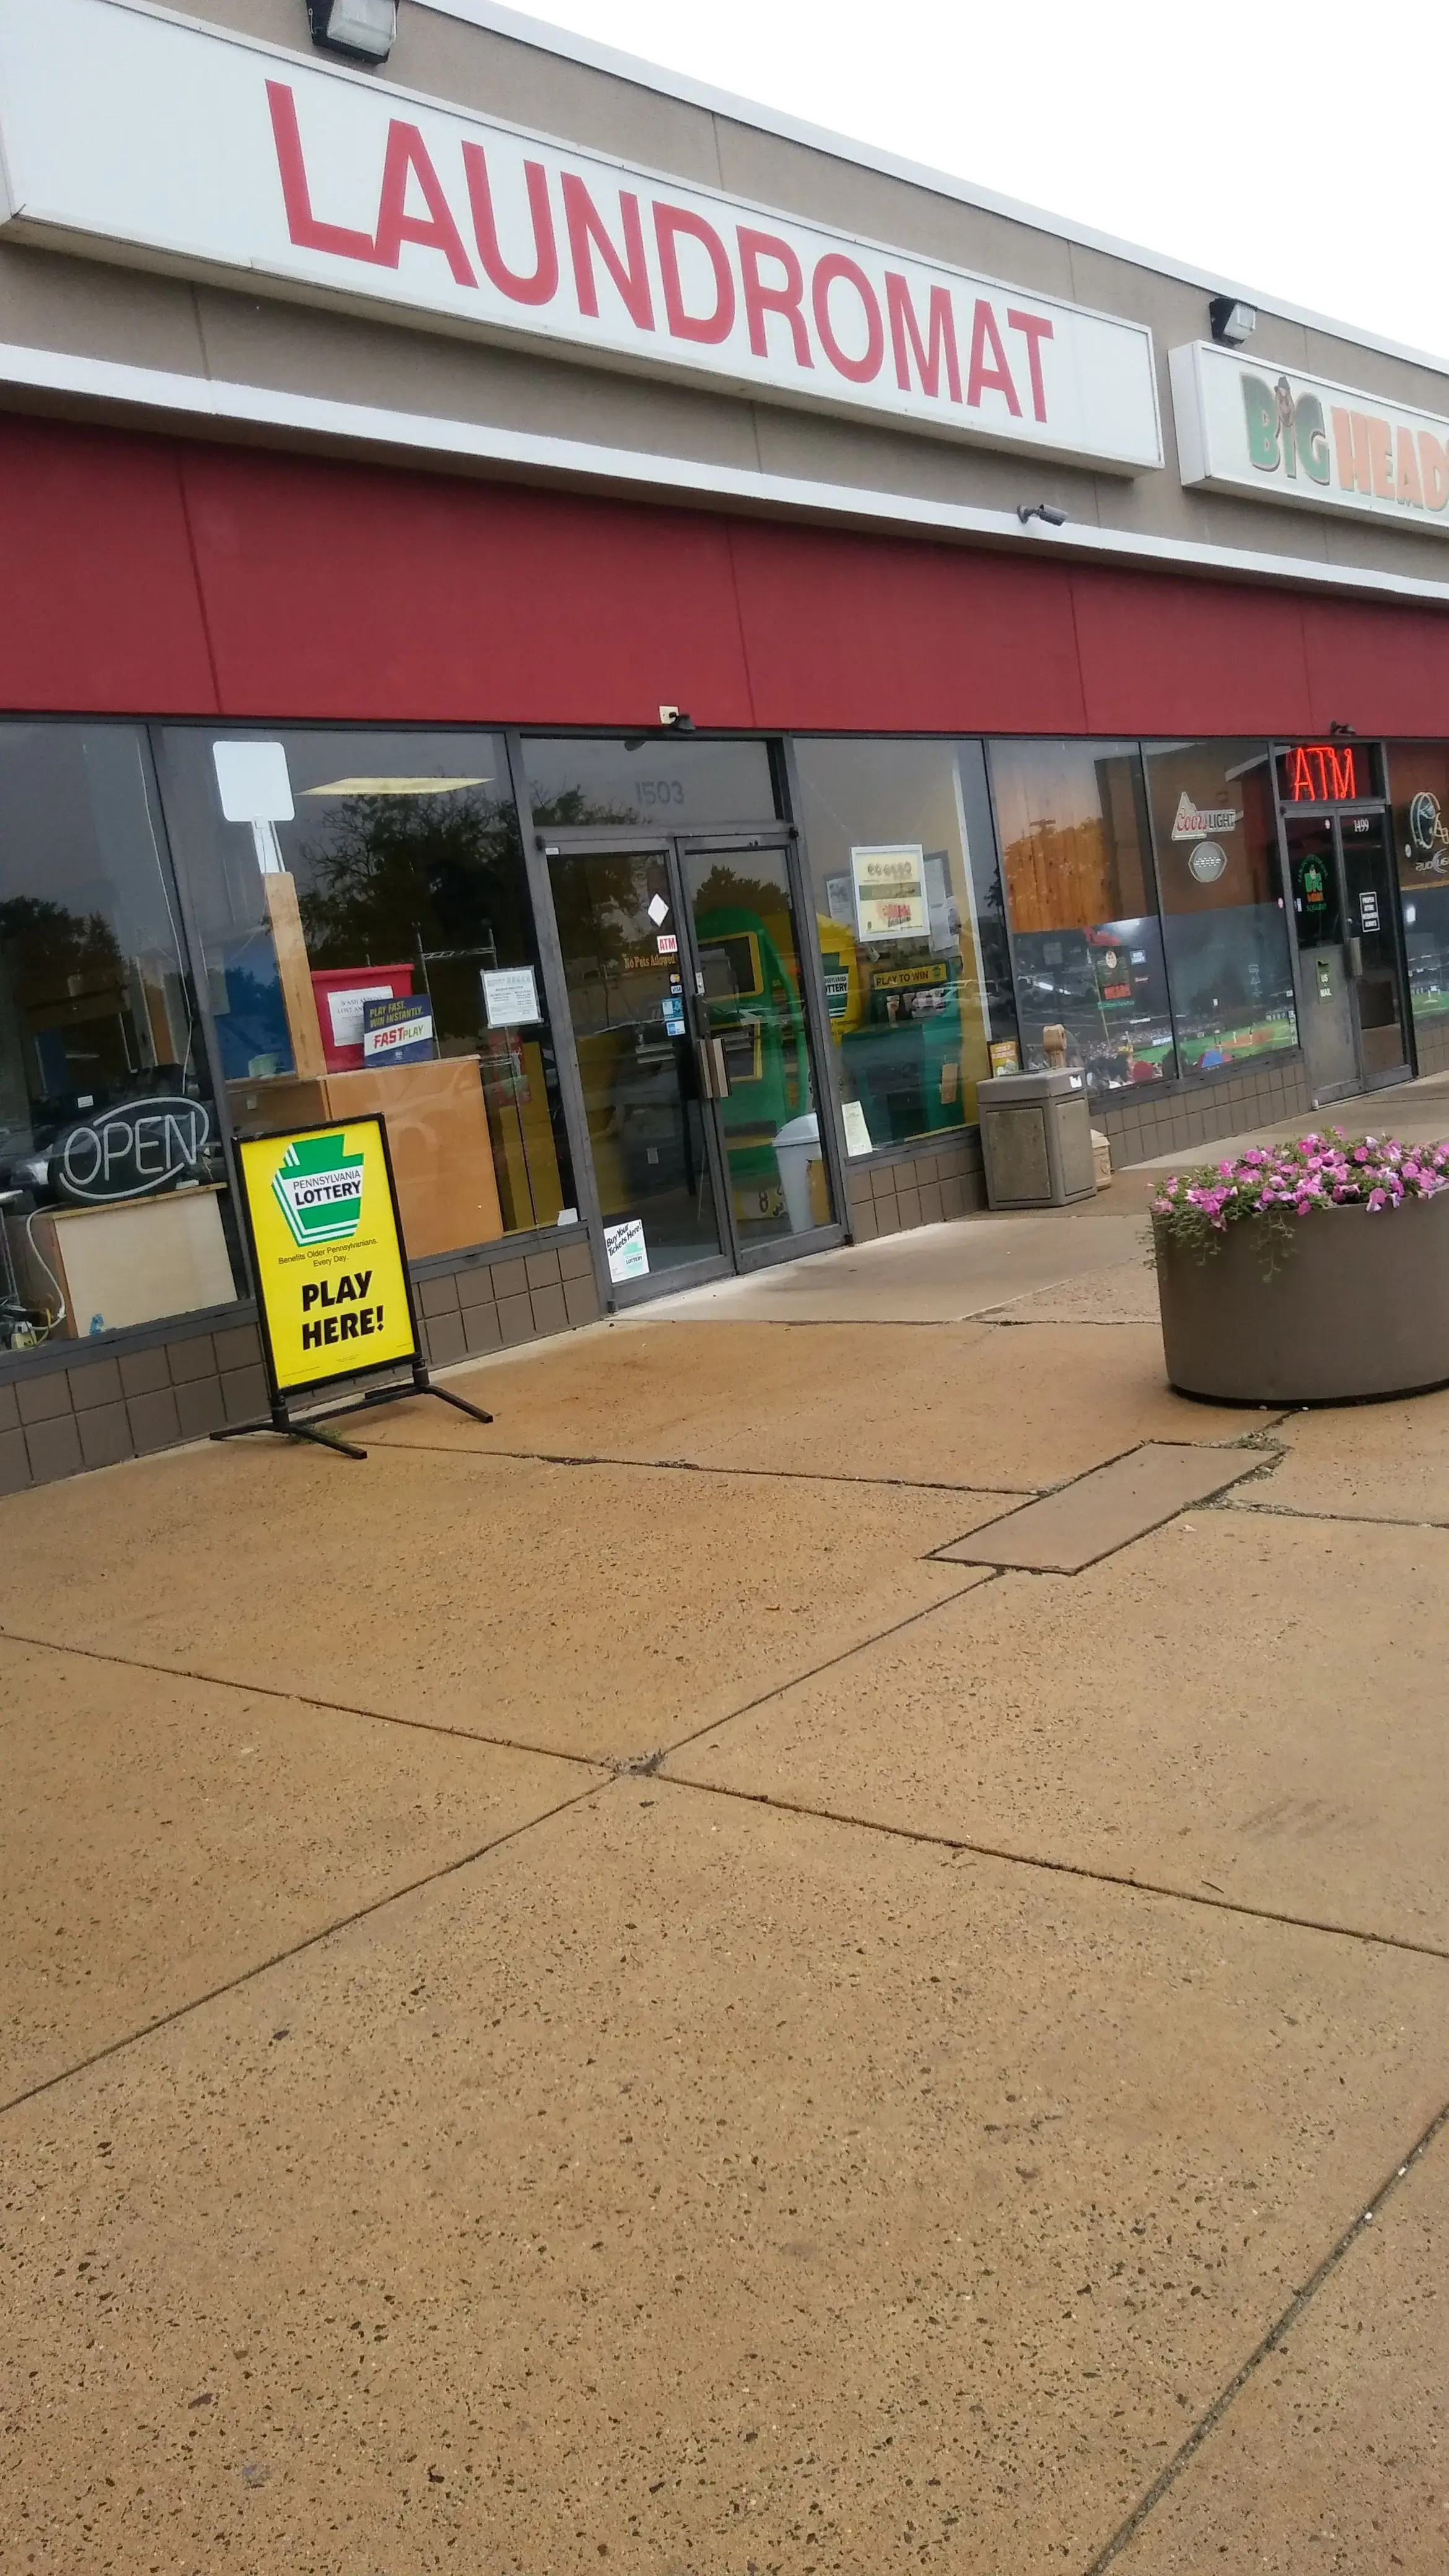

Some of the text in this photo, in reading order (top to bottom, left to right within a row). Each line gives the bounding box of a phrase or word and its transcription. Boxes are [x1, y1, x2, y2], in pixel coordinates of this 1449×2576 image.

[265, 80, 1053, 424] LAUNDROMAT
[1240, 371, 1449, 513] BIG HEAD
[1294, 747, 1356, 802] ATM
[635, 781, 684, 806] 1503
[1208, 812, 1235, 830] LIGHT
[1353, 819, 1370, 833] 1499
[659, 937, 676, 951] ATM
[624, 953, 676, 968] No Pets Allowed
[876, 970, 929, 986] PLAY TO WIN
[1320, 973, 1328, 983] US
[370, 1000, 406, 1018] PLAY FAST.
[370, 1016, 385, 1028] WIN
[386, 1006, 424, 1024] INSTANTLY.
[64, 1111, 197, 1185] OPEN
[293, 1170, 361, 1190] PENNSYLVANIA
[294, 1180, 362, 1206] LOTTERY
[606, 1224, 629, 1248] Buy Your
[609, 1221, 642, 1256] Tickets Here!
[279, 1238, 378, 1264] Benefits Older Pennsylvanians.
[313, 1255, 349, 1267] Every Day.
[626, 1256, 643, 1264] LOTTERY
[302, 1270, 373, 1312] PLAY
[302, 1305, 385, 1351] HERE!
